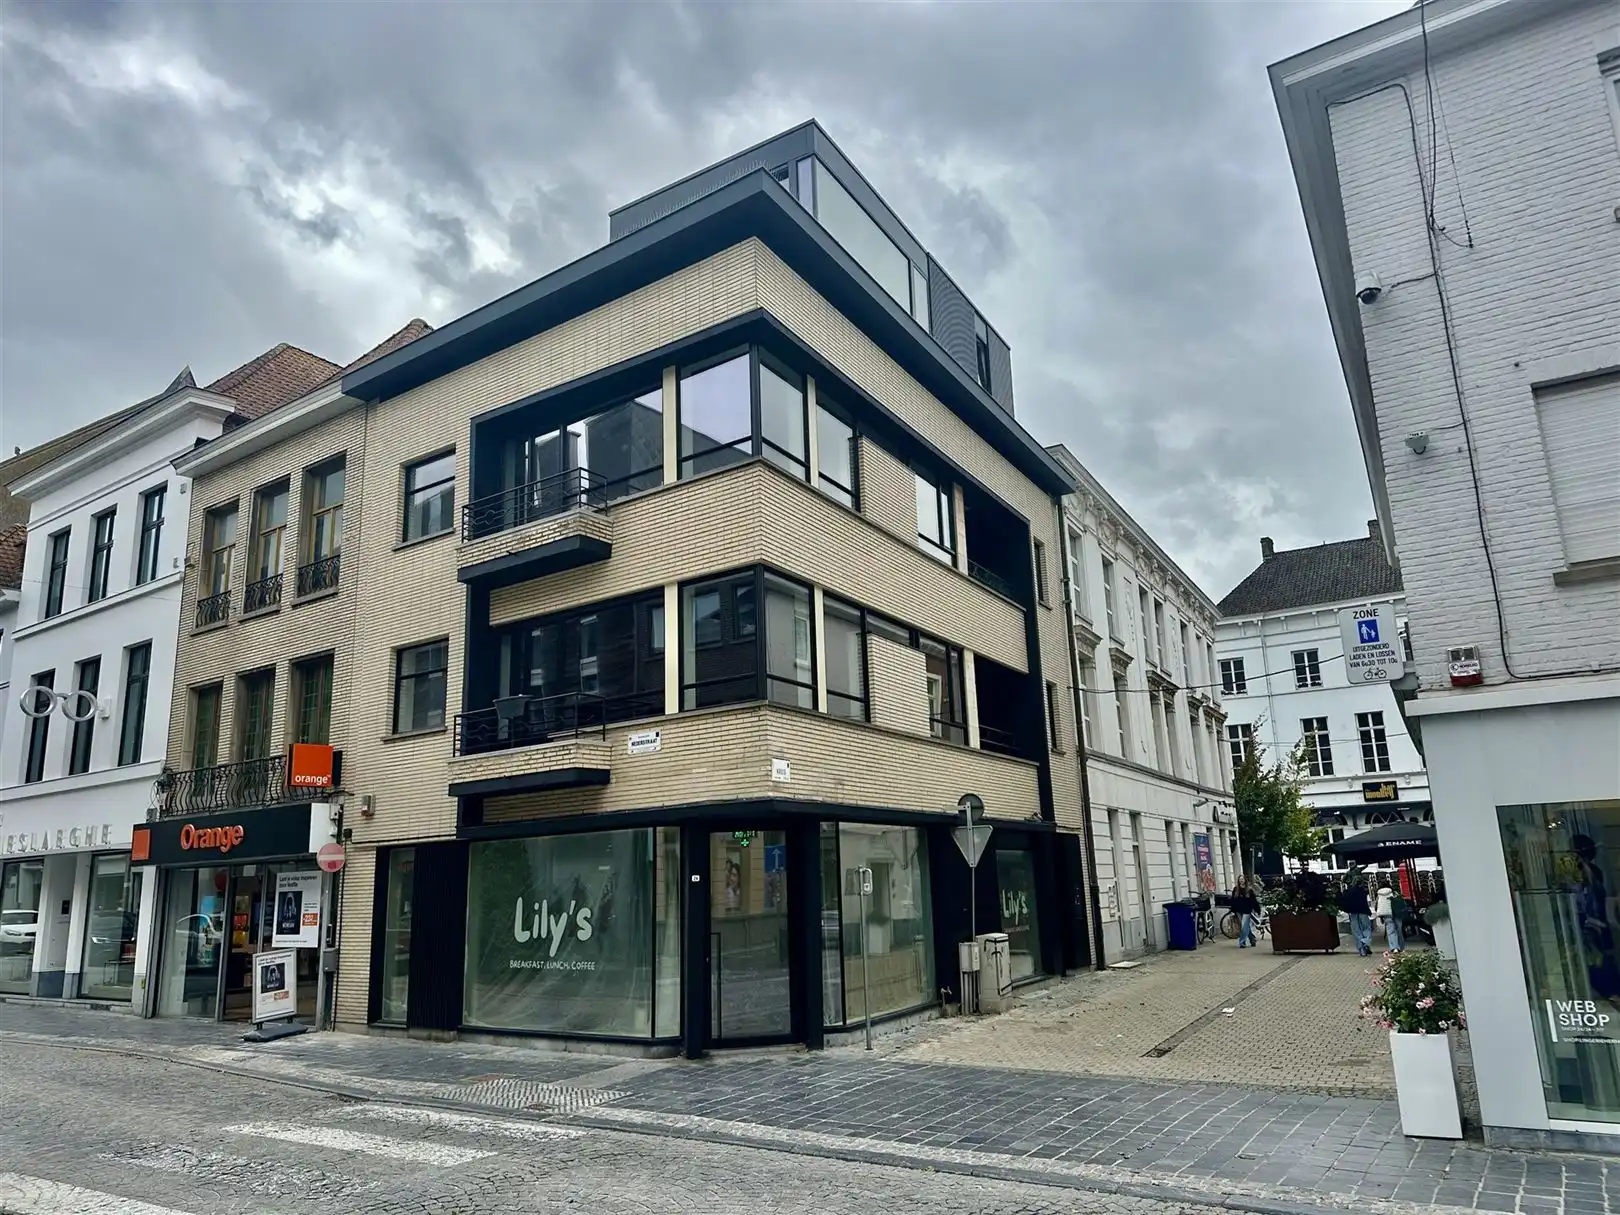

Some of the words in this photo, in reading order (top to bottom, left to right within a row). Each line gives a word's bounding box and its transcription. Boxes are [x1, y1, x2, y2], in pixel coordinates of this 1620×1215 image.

[1352, 608, 1380, 620] ZONE
[1352, 642, 1390, 653] UITGEZONDERD
[1349, 652, 1366, 661] LADEN
[1367, 651, 1375, 660] EN
[1375, 649, 1396, 659] LOSSEN
[1361, 659, 1376, 667] 6u30
[1376, 658, 1387, 666] TOT
[295, 774, 328, 786] orange
[180, 823, 244, 853] Orange
[1385, 839, 1422, 847] ENAME
[1002, 889, 1028, 925] Lily's
[514, 896, 592, 957] Lily's
[571, 961, 596, 971] COFFEE
[1556, 1000, 1597, 1013] WEB
[1559, 1013, 1610, 1027] SHOP
